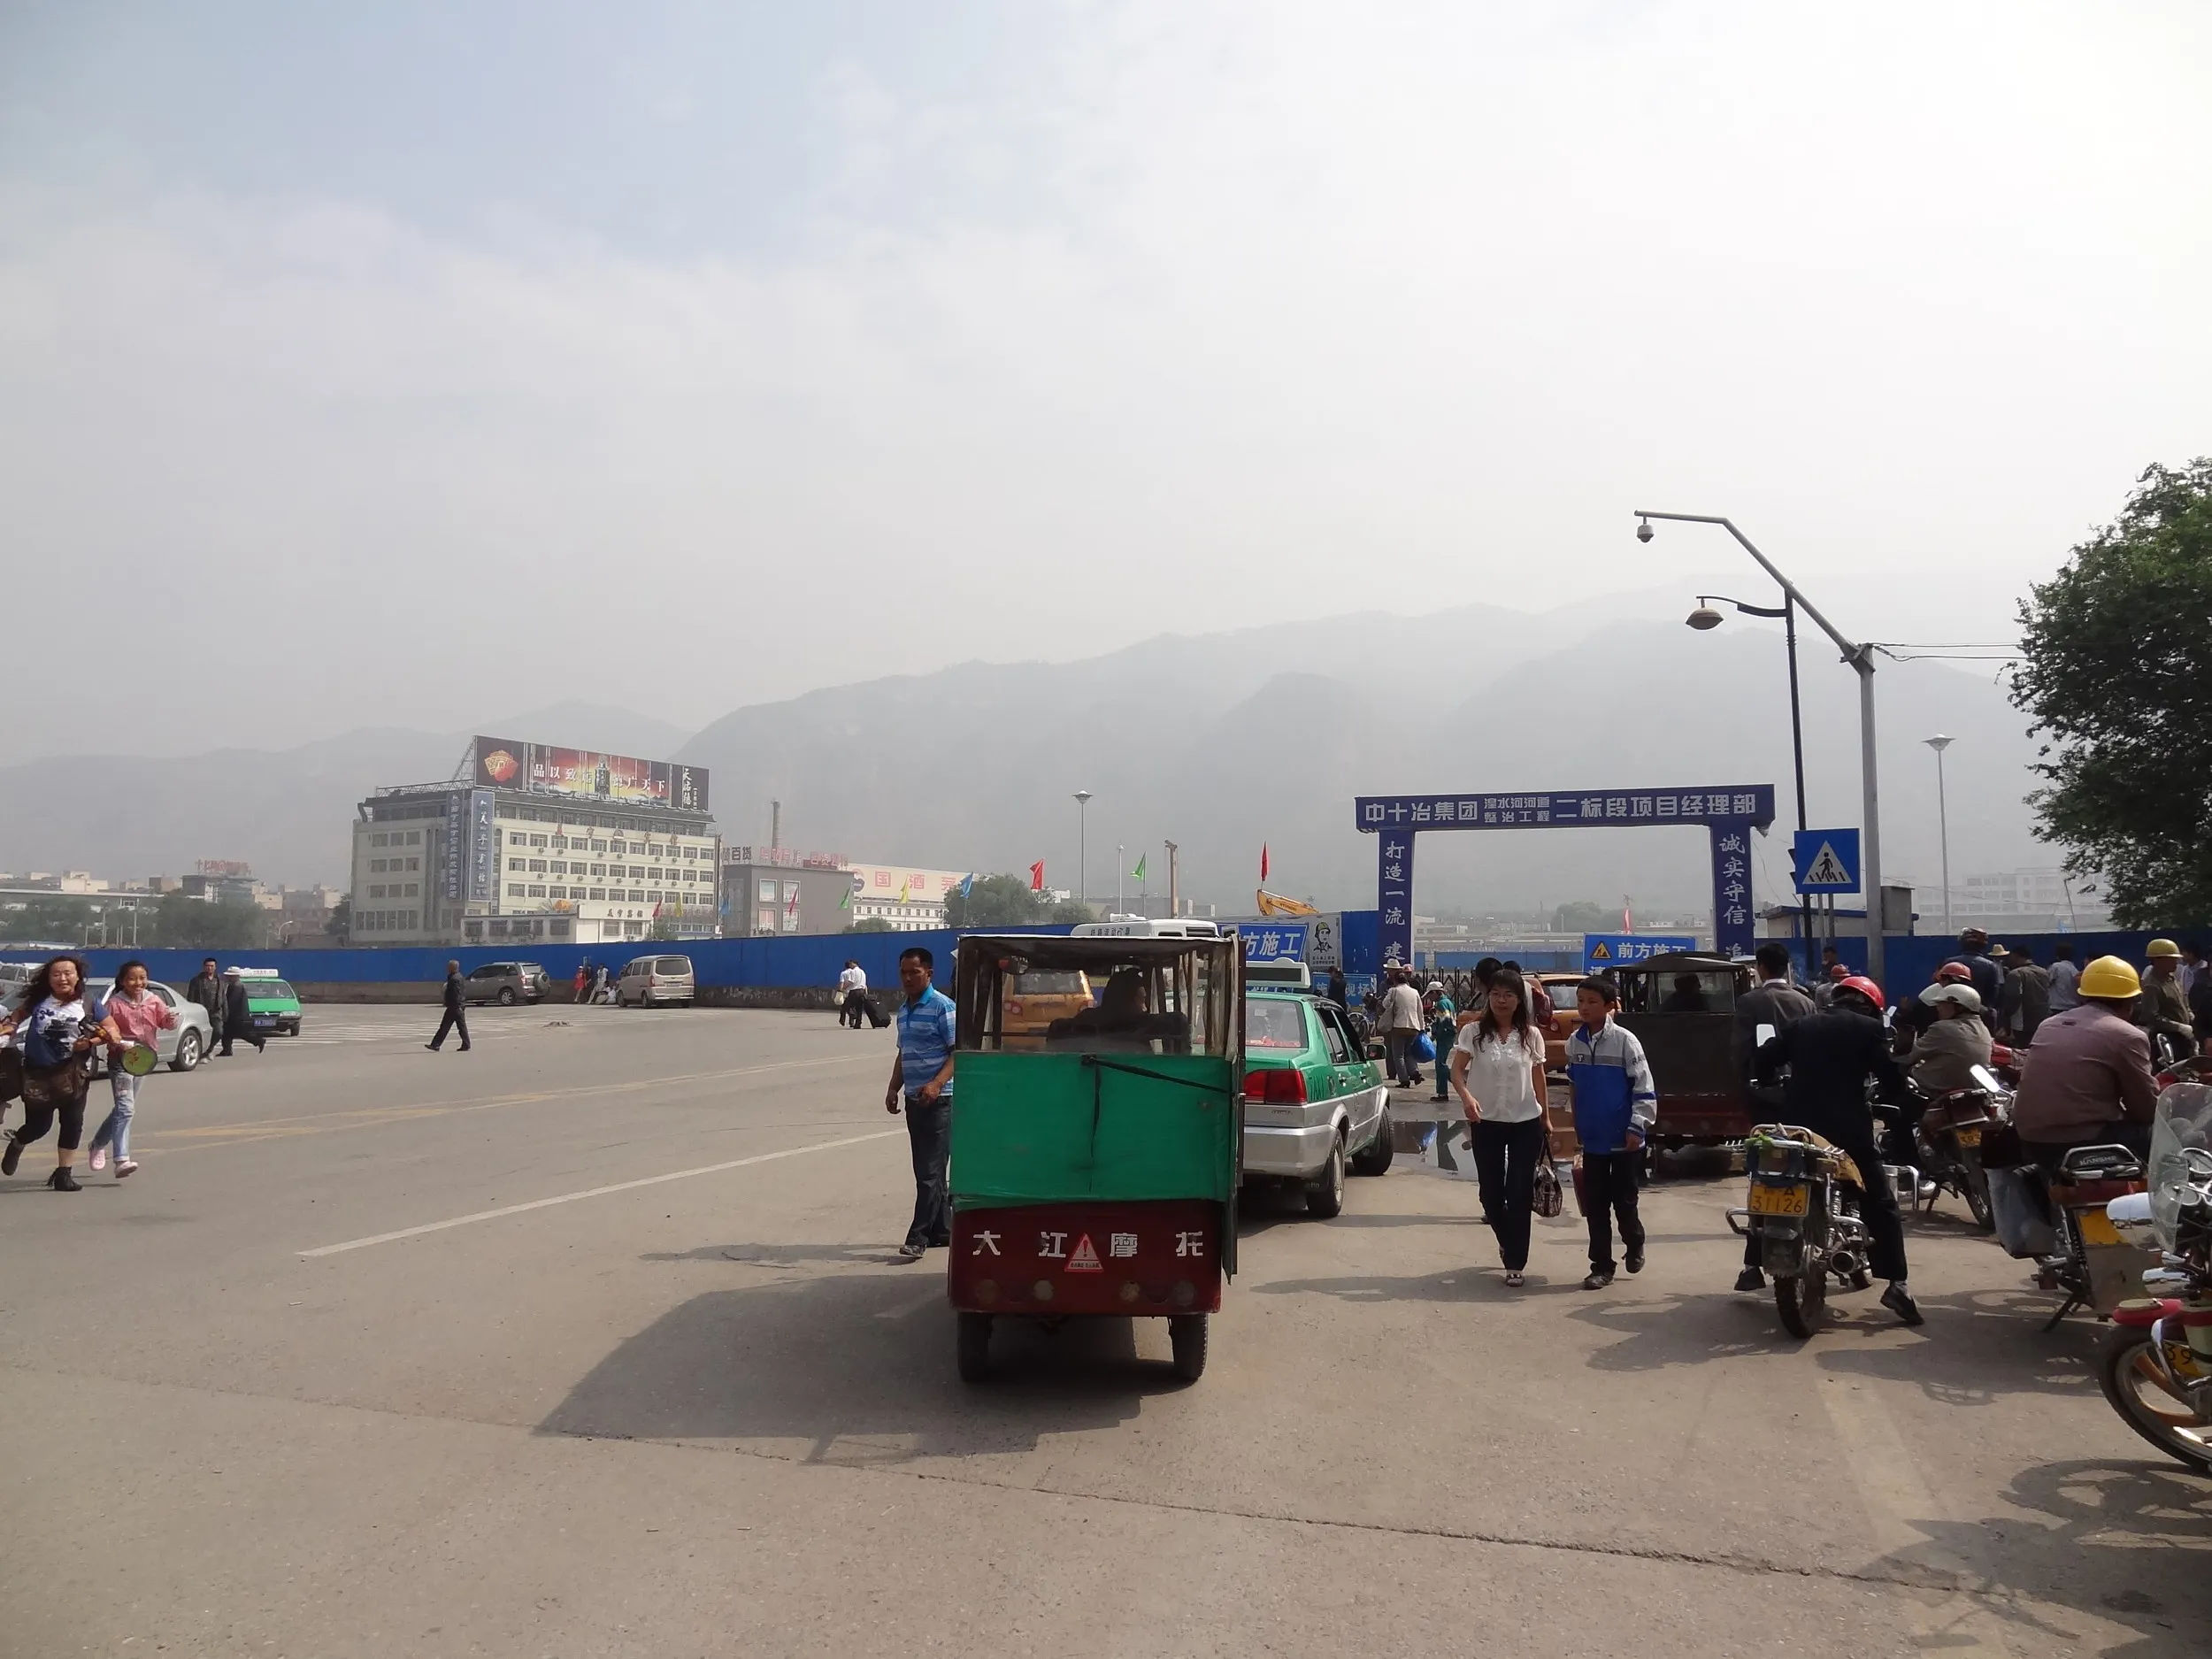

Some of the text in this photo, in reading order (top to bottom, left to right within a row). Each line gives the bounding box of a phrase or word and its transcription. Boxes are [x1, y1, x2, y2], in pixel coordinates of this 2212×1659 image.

[1365, 801, 1478, 822] 中十冶集团
[1484, 810, 1550, 823] 整治工程
[1556, 794, 1756, 818] 二标段项目经理部
[1384, 841, 1405, 926] 打造一流
[1718, 833, 1747, 925] 诚实守信
[1753, 1195, 1802, 1213] 31126
[972, 1230, 1203, 1257] 大江摩托
